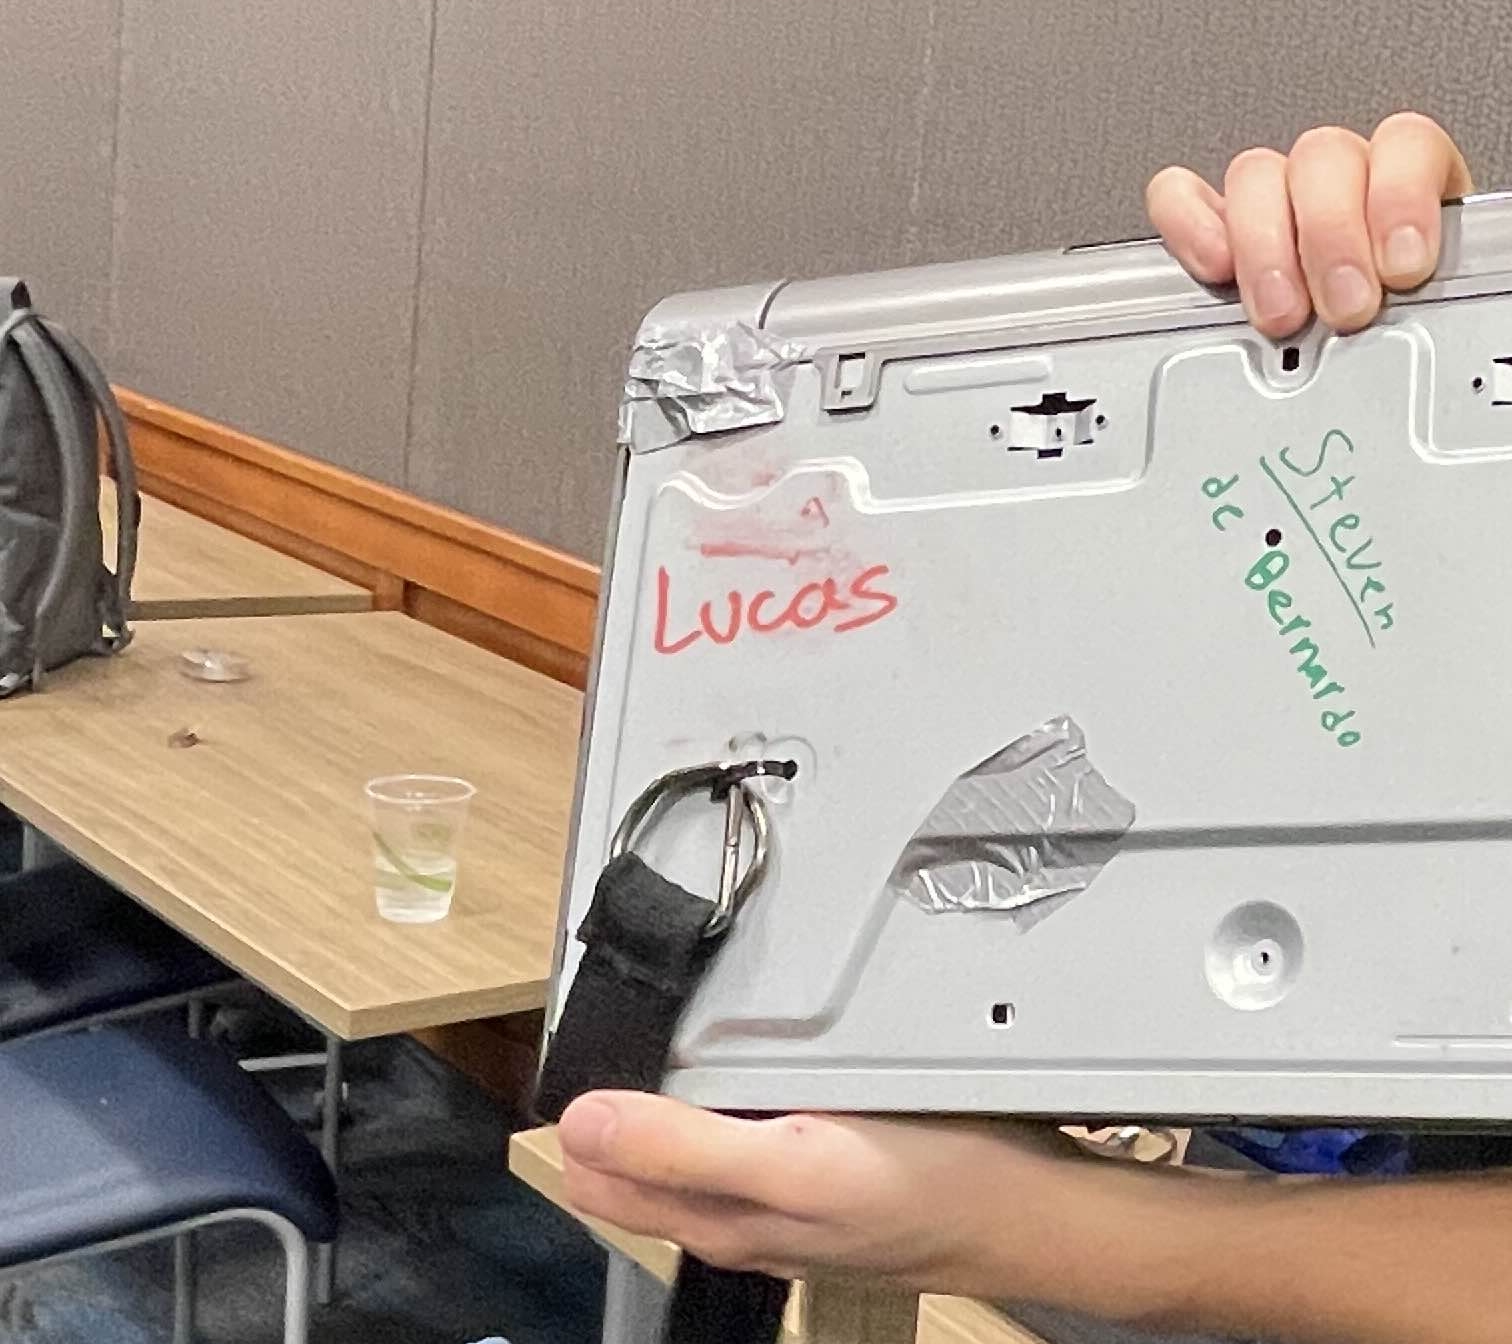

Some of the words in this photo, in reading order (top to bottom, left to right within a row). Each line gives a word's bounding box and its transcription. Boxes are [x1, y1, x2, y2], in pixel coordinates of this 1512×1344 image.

[654, 564, 898, 655] Lucas
[1279, 428, 1395, 631] Steven
[1244, 549, 1361, 748] Bernardo
